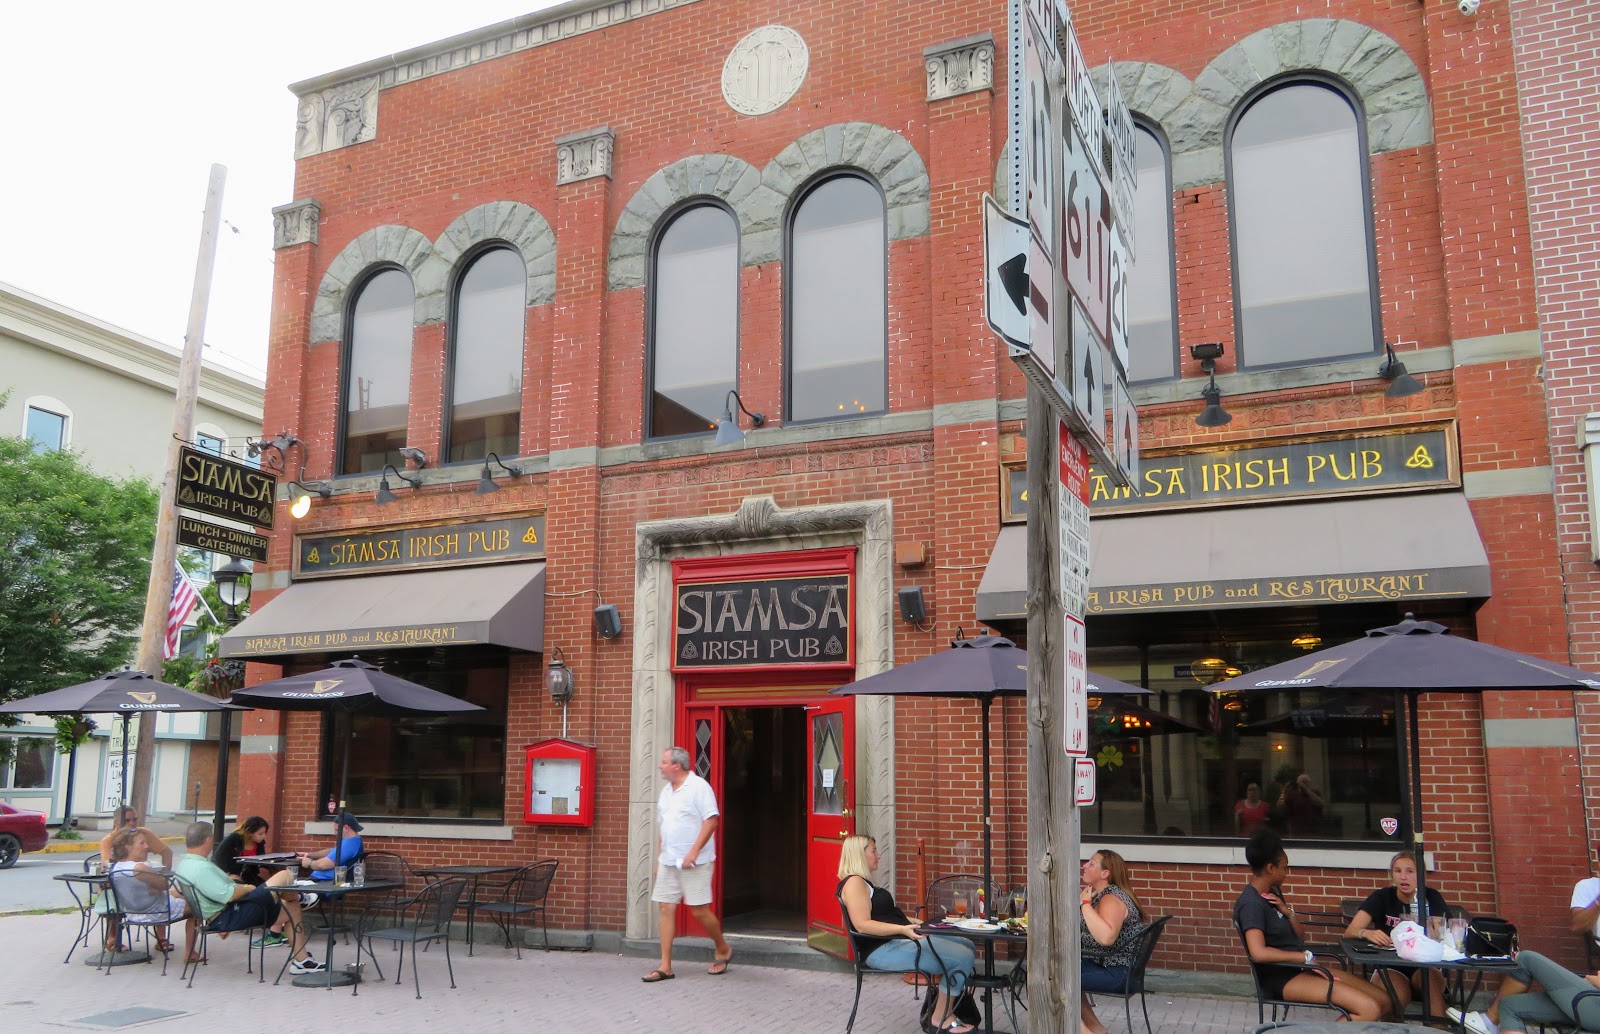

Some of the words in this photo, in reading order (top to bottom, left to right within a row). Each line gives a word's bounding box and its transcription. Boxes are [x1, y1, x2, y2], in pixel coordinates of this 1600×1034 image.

[1071, 42, 1100, 159] NORTH
[1112, 80, 1136, 175] SOUTH
[1067, 170, 1104, 304] 611
[1066, 431, 1082, 460] SNOW
[1062, 444, 1087, 484] EMERGENCY
[1200, 457, 1290, 492] IRISH
[1306, 450, 1384, 483] PUB
[182, 454, 274, 504] SIAMSA
[1067, 471, 1082, 499] ROUTE
[196, 491, 228, 510] IRISH
[232, 501, 258, 518] PUB
[182, 520, 220, 538] LUNCH
[228, 531, 267, 549] DINNER
[197, 536, 252, 557] CATERING
[409, 533, 459, 558] IRISH
[468, 529, 511, 553] PUB
[1108, 588, 1164, 606] IRISH
[1173, 584, 1215, 603] PUB
[1225, 583, 1259, 598] and
[1269, 572, 1430, 602] RESTAURANT
[677, 584, 849, 635] SIAMSA
[245, 636, 287, 653] SIAMSA
[291, 634, 321, 648] IRISH
[325, 633, 348, 645] PUB
[352, 631, 370, 642] and
[375, 626, 459, 646] RESTAURANT
[702, 639, 759, 660] IRISH
[769, 637, 821, 659] PUB
[1068, 649, 1083, 670] PARKING
[112, 735, 137, 749] TRUKS
[1381, 820, 1397, 828] AIC
